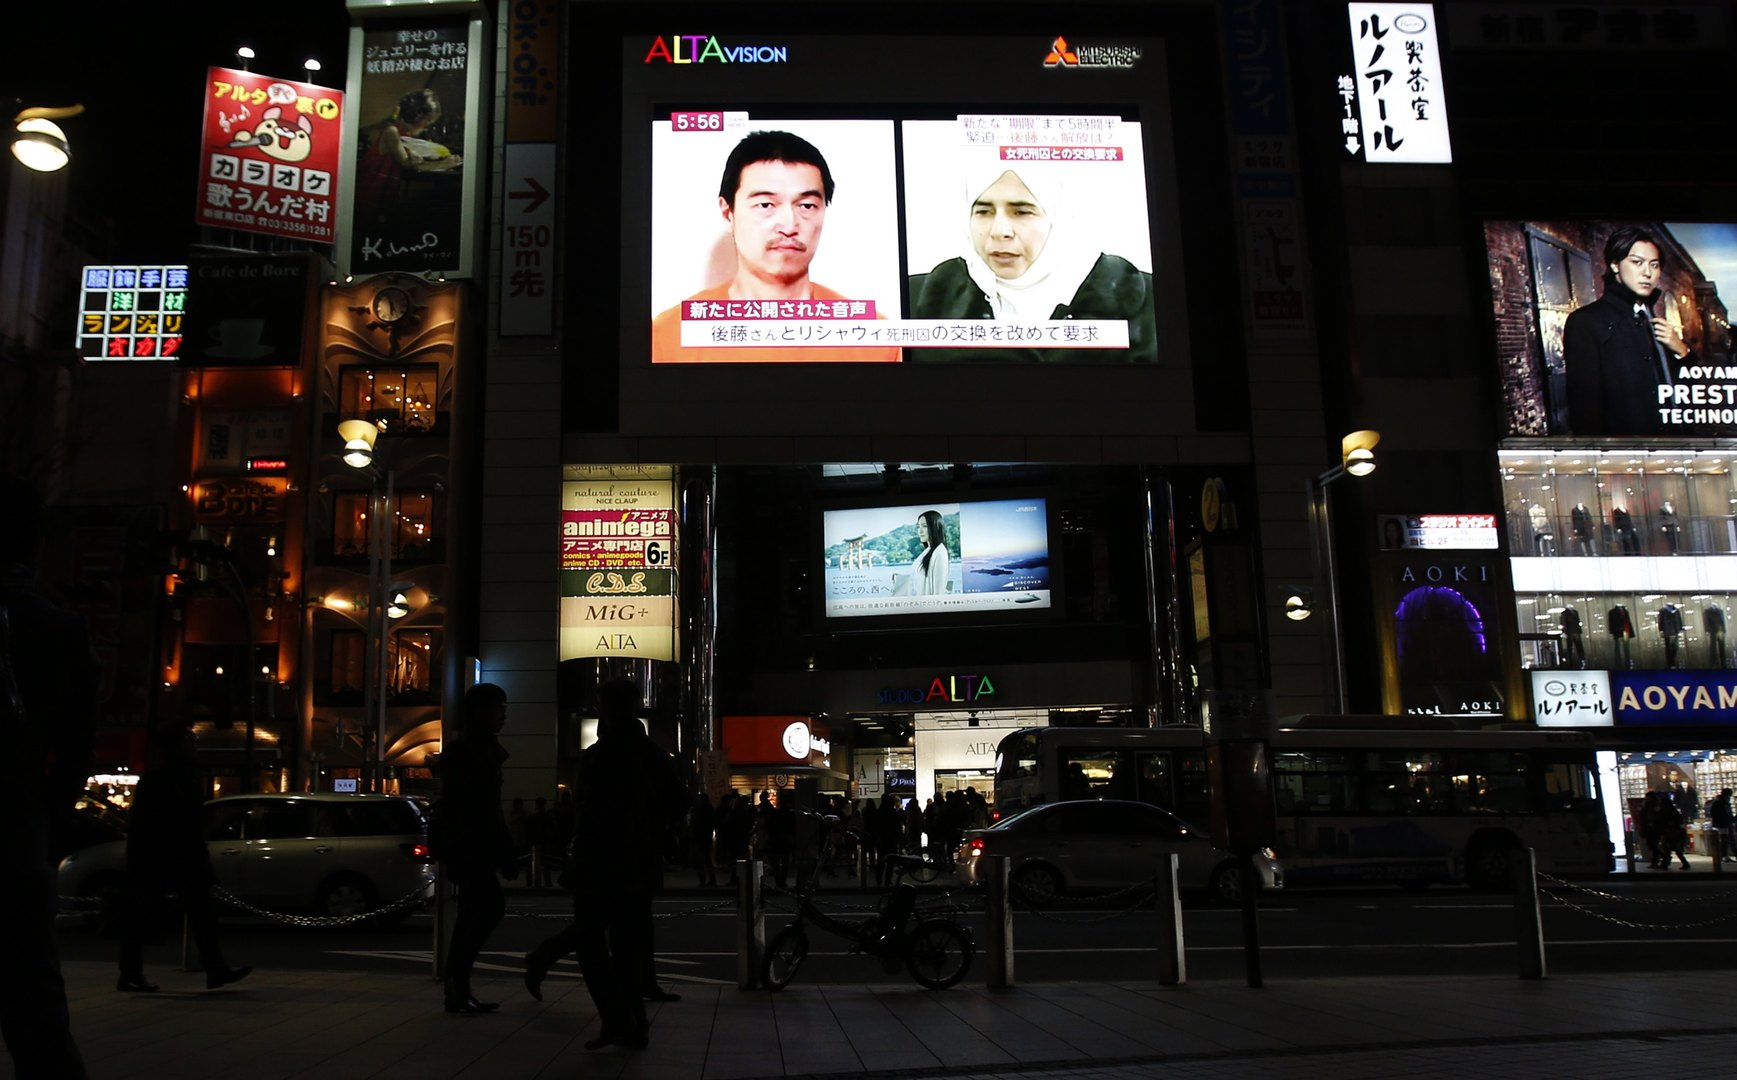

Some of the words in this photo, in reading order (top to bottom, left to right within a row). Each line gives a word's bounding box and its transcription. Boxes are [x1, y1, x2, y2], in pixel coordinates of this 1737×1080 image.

[366, 42, 467, 58] ジュエリーを作る
[1079, 46, 1140, 56] MITSUBISHI
[1080, 56, 1133, 65] ELECTRIC
[1360, 13, 1404, 152] ルノアール
[214, 81, 268, 105] アルタ
[677, 114, 720, 130] 5:56
[215, 158, 326, 190] カラオケ
[207, 182, 329, 222] 歌うんだ村
[87, 269, 188, 288] 服飾手芸
[690, 301, 867, 319] 新たに公開された音声
[711, 325, 1099, 342] 後藤さんとリシャウィ死刑囚の交換を改めて要求
[1659, 408, 1737, 424] TECHNO
[575, 485, 615, 497] natural
[619, 487, 659, 497] couture
[631, 511, 668, 520] アニメガ
[563, 540, 644, 552] アニメ専門店
[647, 542, 669, 564] 6F
[597, 552, 644, 560] animegoods
[1402, 566, 1487, 582] AOKI
[595, 633, 637, 650] ALTA
[878, 688, 925, 703] STUDIO
[925, 674, 996, 703] ALTA
[1460, 701, 1500, 710] AOKI
[1538, 699, 1608, 716] ルノアール
[965, 742, 996, 755] ALTA
